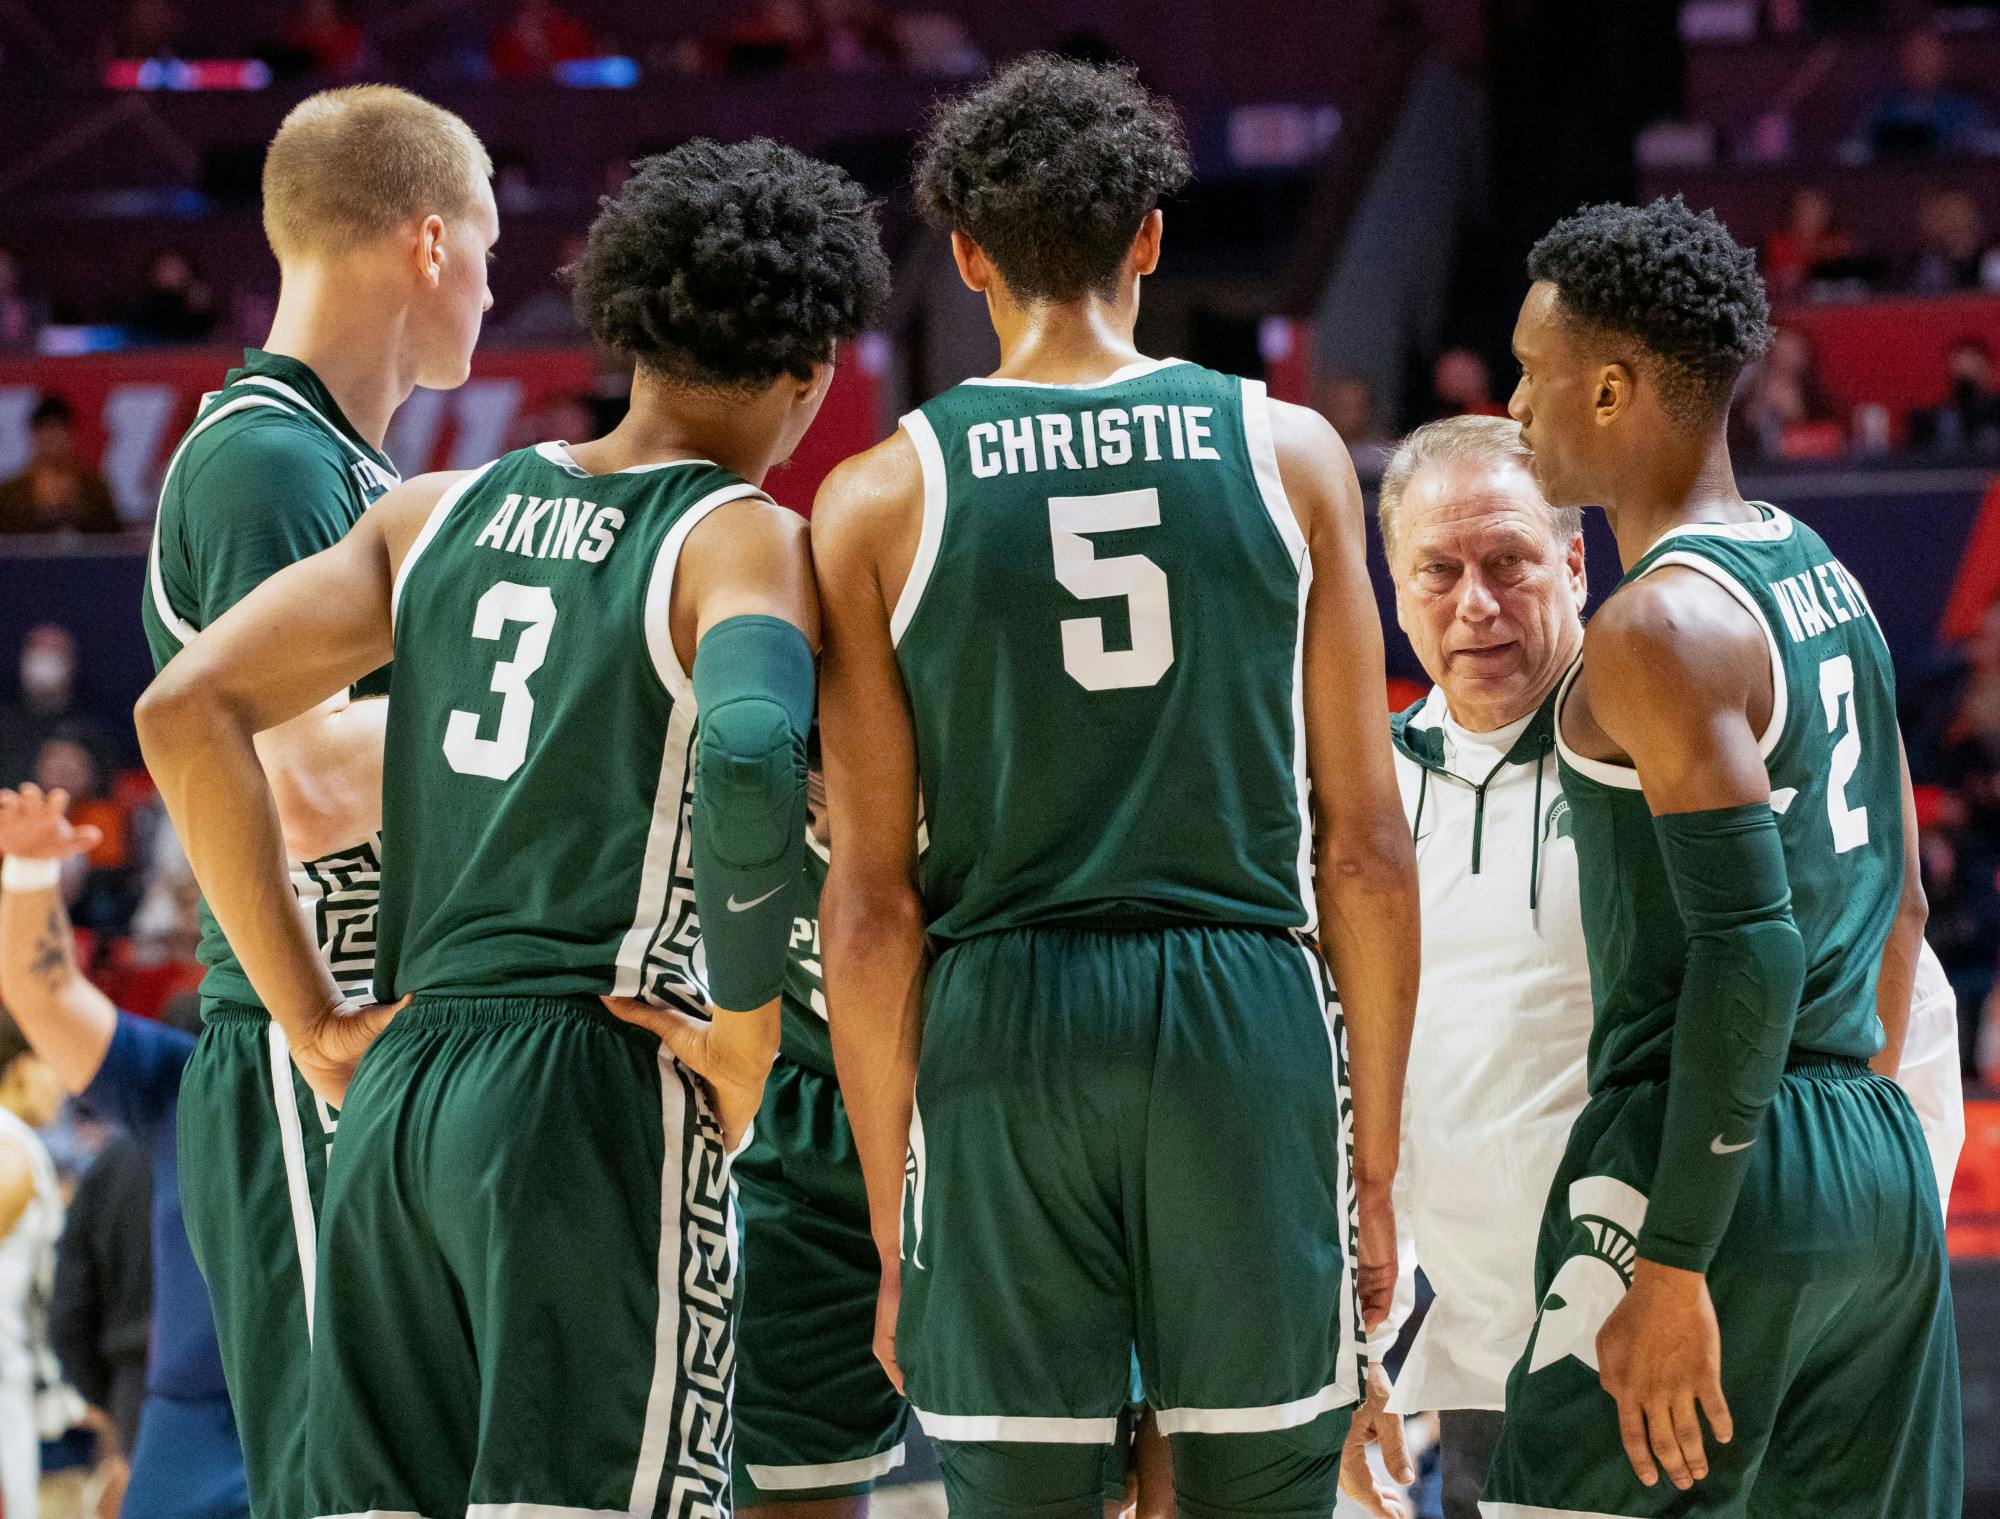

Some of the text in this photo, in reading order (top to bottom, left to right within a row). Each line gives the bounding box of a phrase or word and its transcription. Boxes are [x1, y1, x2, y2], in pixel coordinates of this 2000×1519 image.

[475, 493, 626, 563] AKINS
[967, 405, 1221, 479] CHRISTIE
[442, 580, 558, 782] 3
[1047, 487, 1175, 692] 5
[1818, 654, 1870, 854] 2
